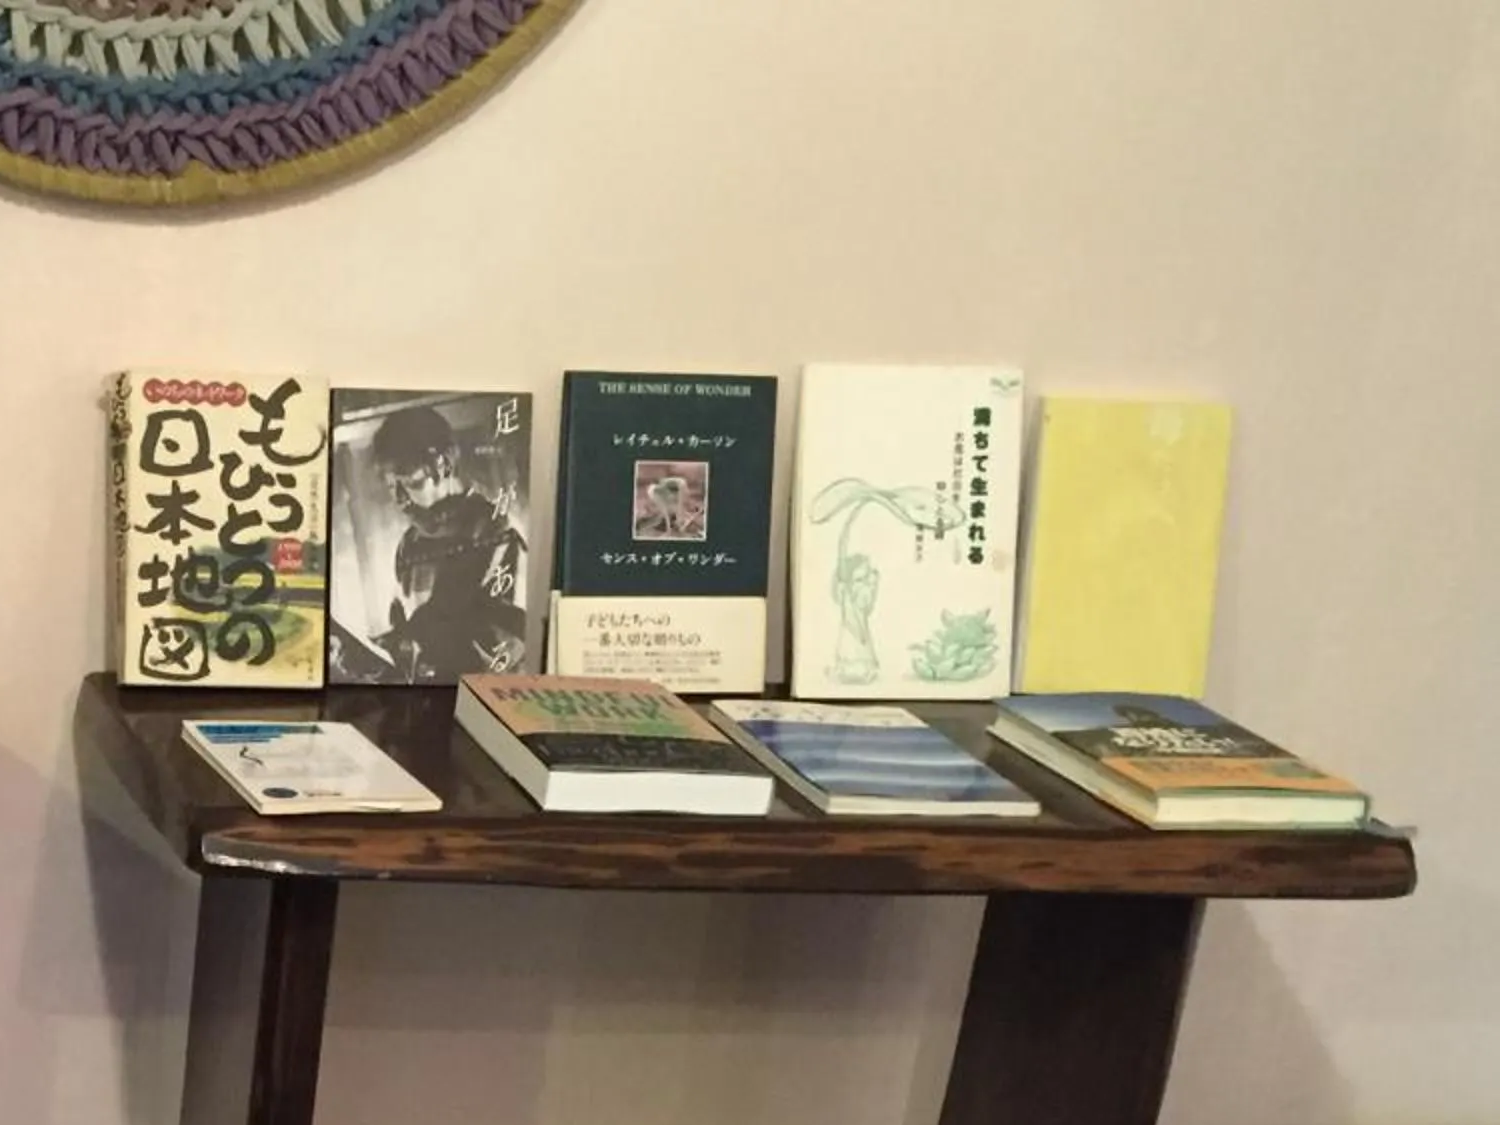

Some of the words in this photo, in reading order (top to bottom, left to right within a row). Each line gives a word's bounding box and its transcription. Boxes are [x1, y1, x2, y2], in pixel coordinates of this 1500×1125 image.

[599, 381, 627, 394] THE
[629, 382, 670, 395] SENSE
[674, 383, 693, 396] OF
[695, 383, 751, 397] WONDER
[134, 408, 220, 681] 日本地図
